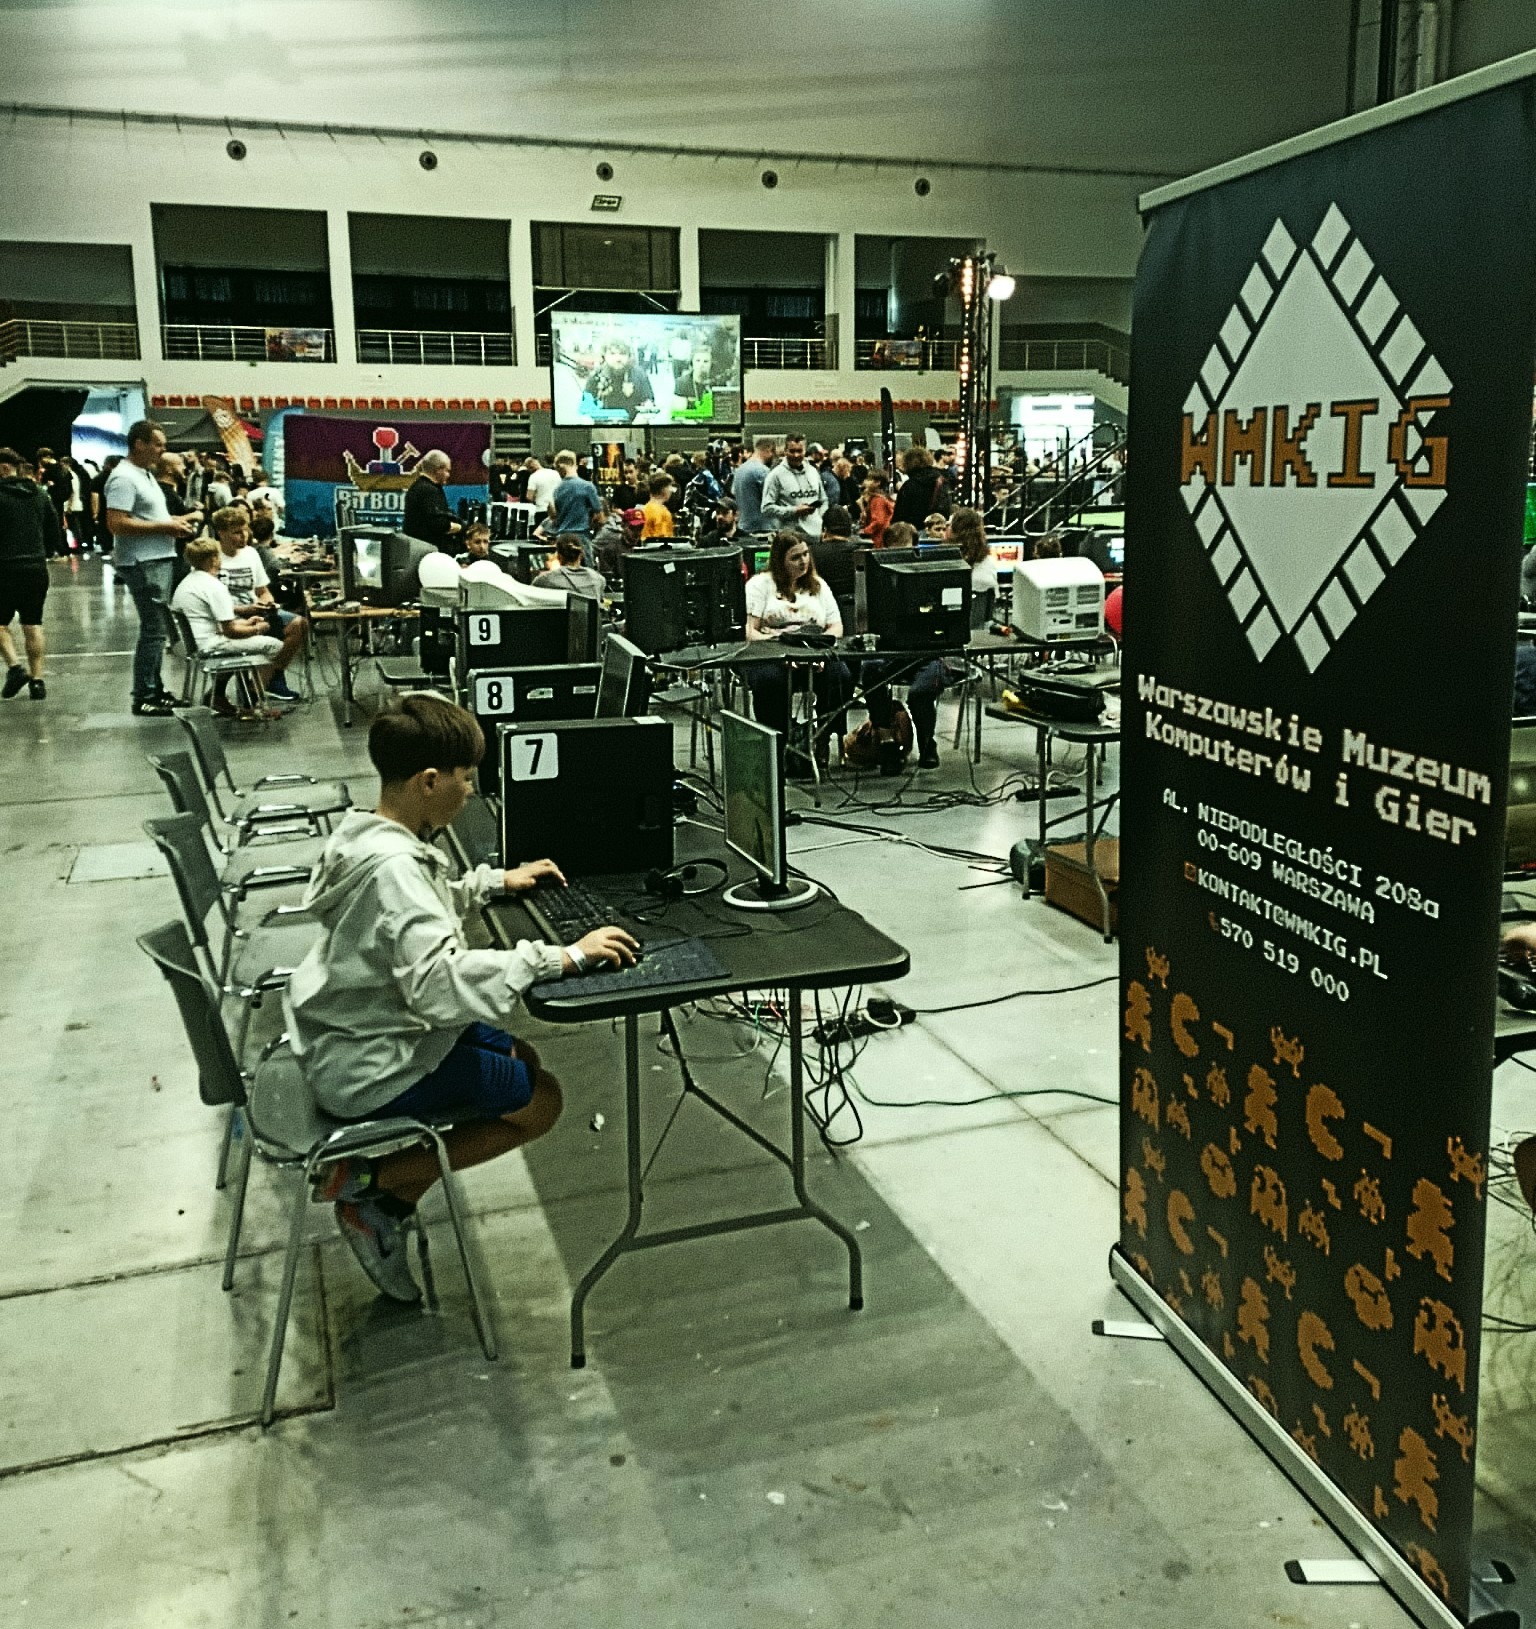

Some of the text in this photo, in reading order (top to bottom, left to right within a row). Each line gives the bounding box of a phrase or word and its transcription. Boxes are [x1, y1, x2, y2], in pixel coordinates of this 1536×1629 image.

[1181, 397, 1451, 488] WMKIG
[479, 618, 491, 641] 9
[487, 681, 502, 710] 8
[1138, 674, 1490, 804] Warszawskie Muzeum
[525, 739, 543, 775] 7
[1145, 711, 1477, 845] Komputerów i Gier
[1163, 788, 1188, 813] AL.
[1376, 875, 1440, 918] 208a
[1198, 830, 1374, 923] 00-609 WARSZAWA
[1198, 869, 1387, 980] KONTAKT@WMKIG.PL
[1220, 918, 1349, 1001] 570 519 000
